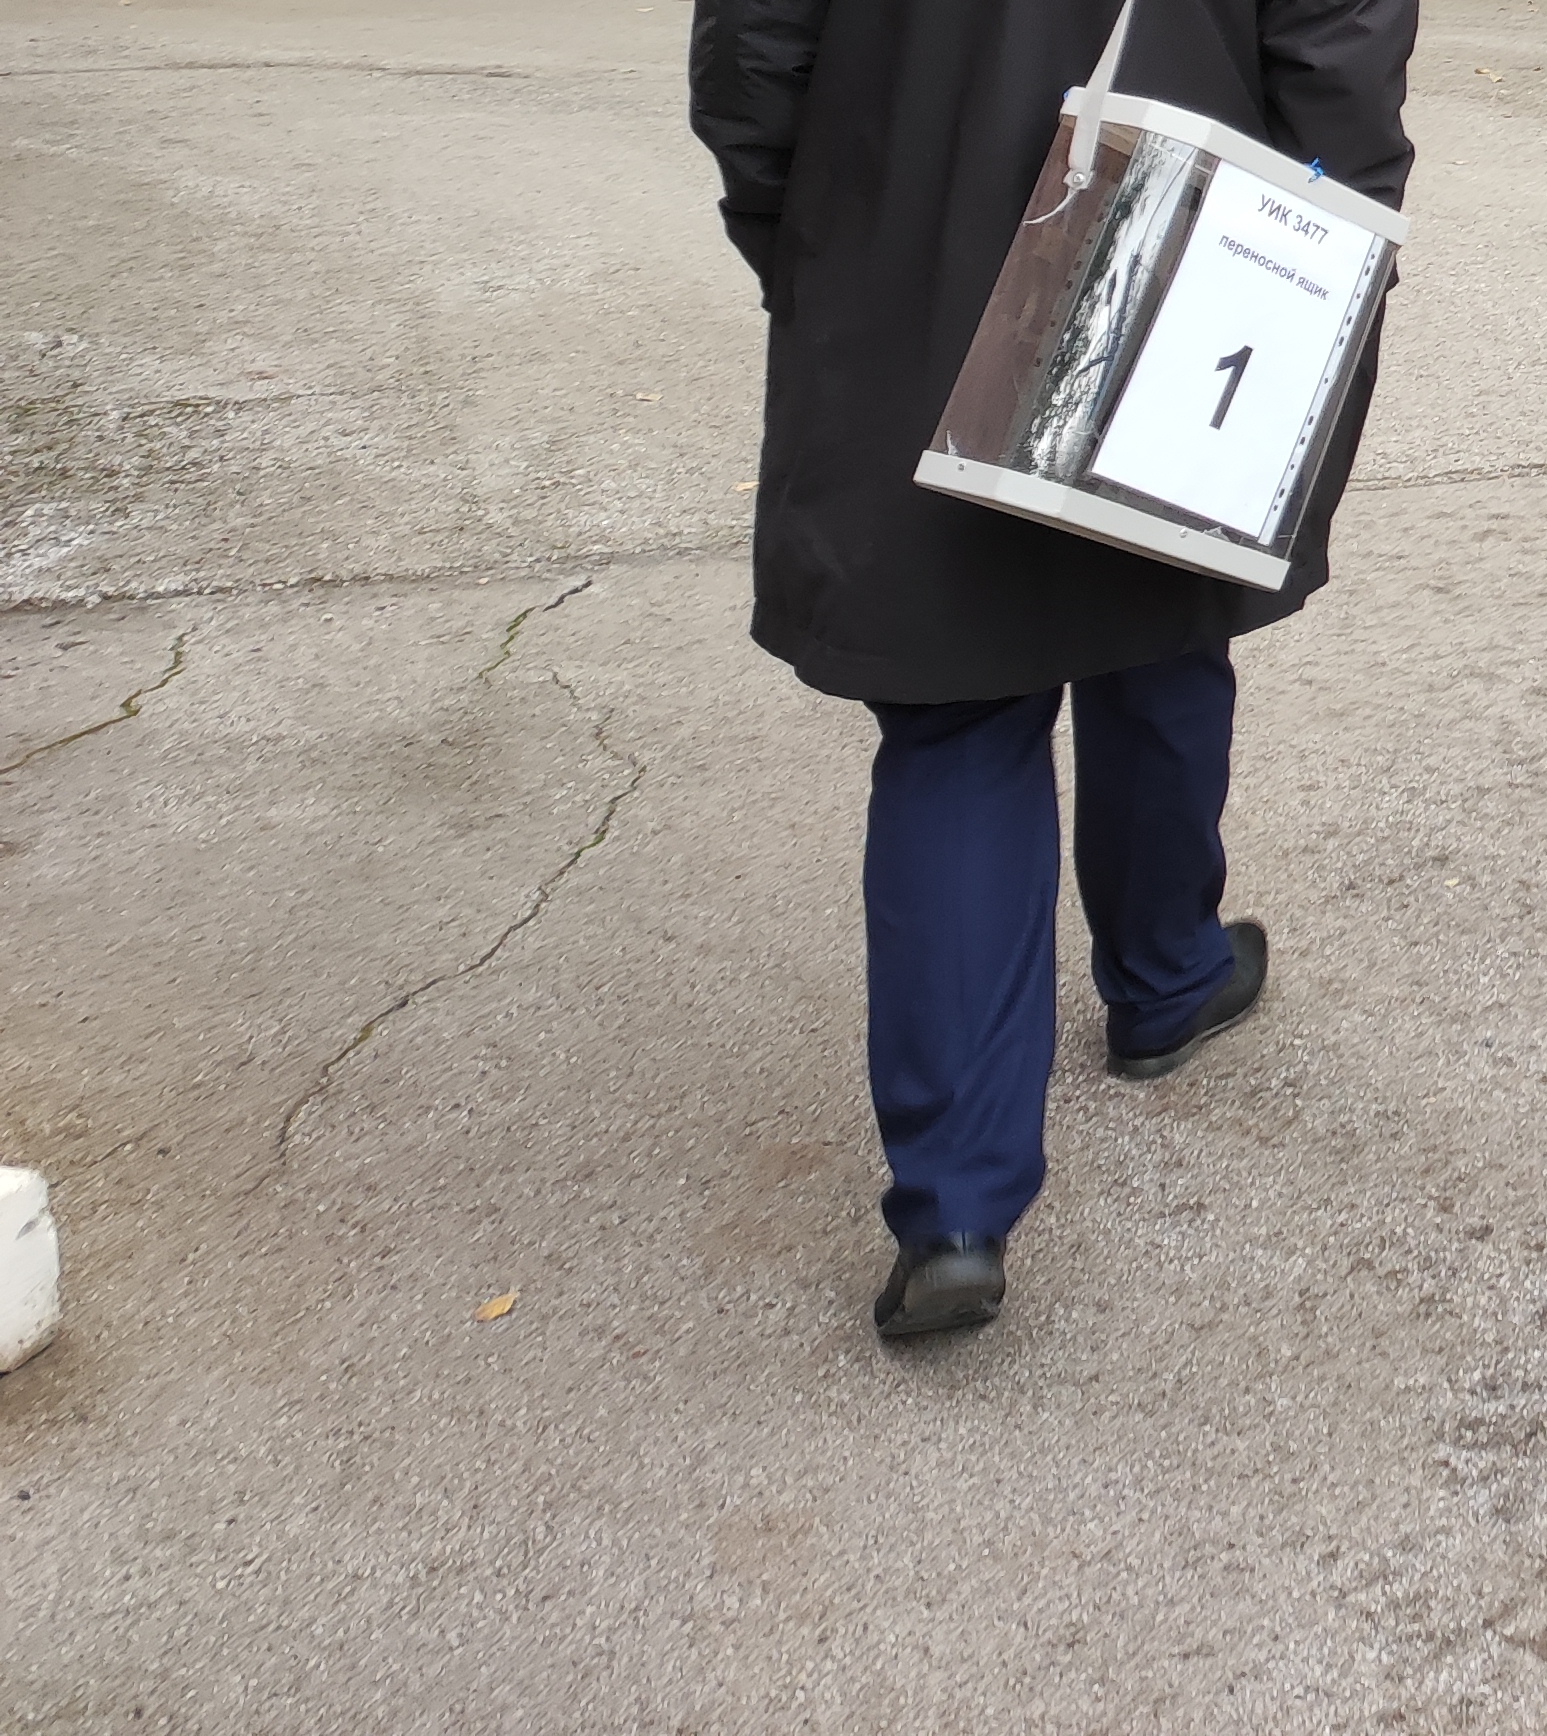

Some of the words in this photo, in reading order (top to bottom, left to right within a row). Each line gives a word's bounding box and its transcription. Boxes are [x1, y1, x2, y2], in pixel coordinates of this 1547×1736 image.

[1258, 193, 1292, 226] УИК
[1293, 214, 1329, 245] 3477
[1219, 234, 1297, 283] переносной
[1295, 276, 1329, 300] ящик
[1209, 344, 1253, 430] 1
